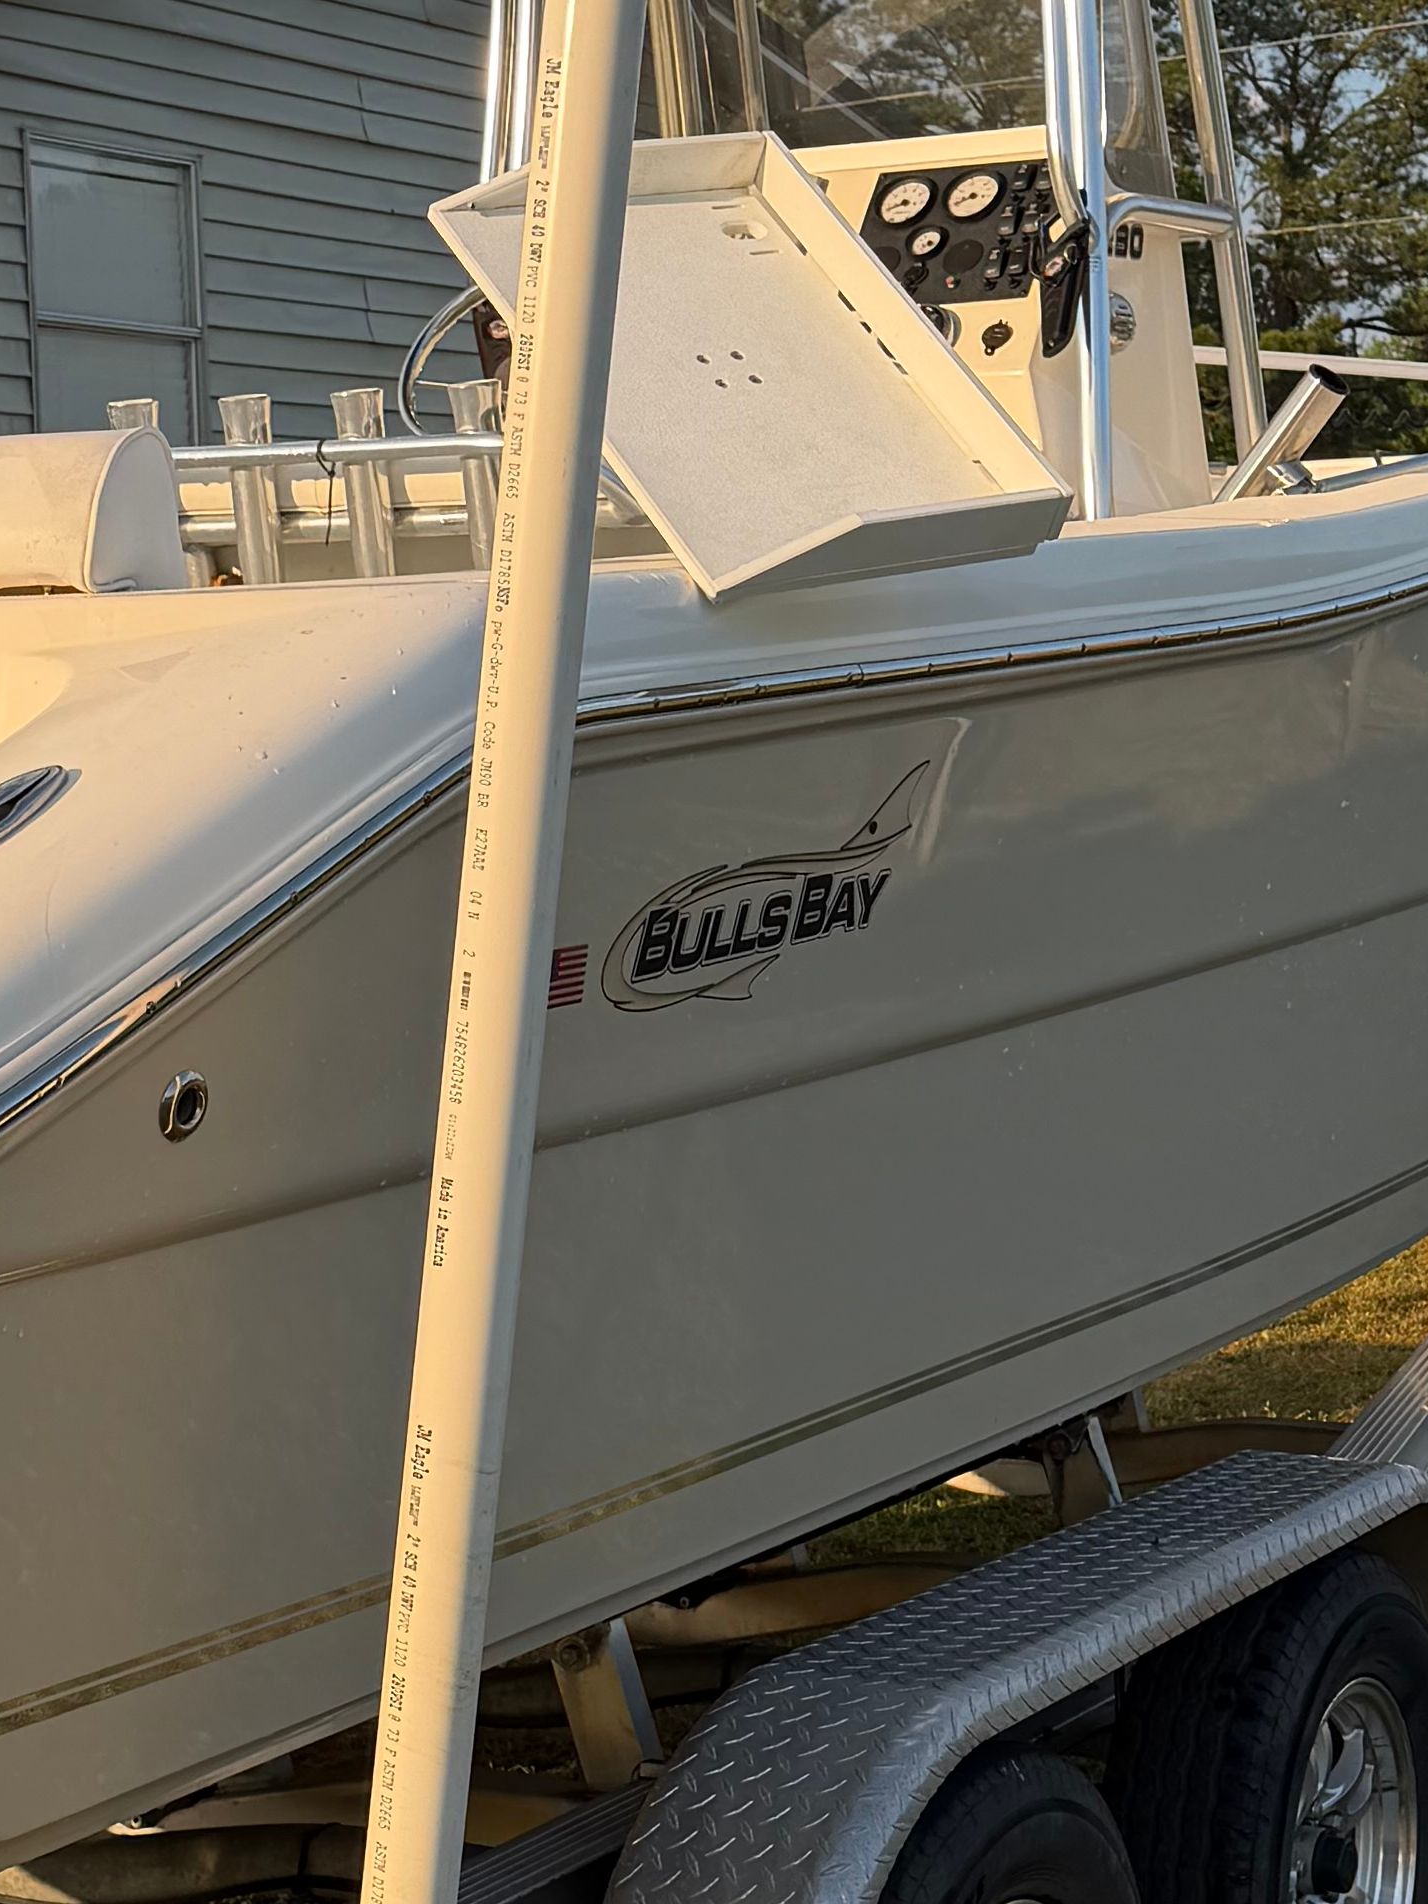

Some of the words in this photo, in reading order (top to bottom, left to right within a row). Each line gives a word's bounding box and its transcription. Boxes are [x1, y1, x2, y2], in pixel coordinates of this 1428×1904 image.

[545, 57, 563, 76] JM
[539, 79, 560, 120] Eagle
[534, 179, 551, 193] 2"
[530, 223, 546, 238] 40
[524, 264, 540, 289] PVC
[521, 295, 537, 324] 1120
[513, 390, 528, 406] 73
[512, 411, 525, 422] F
[508, 425, 525, 457] ASTM
[505, 462, 522, 500] D2665
[500, 512, 516, 544] ASTM
[481, 720, 497, 751] Code
[476, 792, 490, 808] BR
[630, 888, 793, 984] BULLS
[790, 869, 892, 945] BAY
[462, 948, 477, 959] 2
[447, 1019, 470, 1105] 754826203458
[438, 1175, 455, 1203] Made
[437, 1206, 453, 1221] in
[432, 1223, 450, 1268] America
[416, 1423, 433, 1443] JM
[410, 1443, 432, 1480] Eagle
[401, 1574, 417, 1589] 40
[393, 1637, 409, 1668] 1120
[386, 1727, 401, 1744] 73
[384, 1746, 397, 1758] F
[381, 1759, 396, 1792] ASTM
[377, 1794, 393, 1832] D2665
[373, 1840, 388, 1874] ASTM
